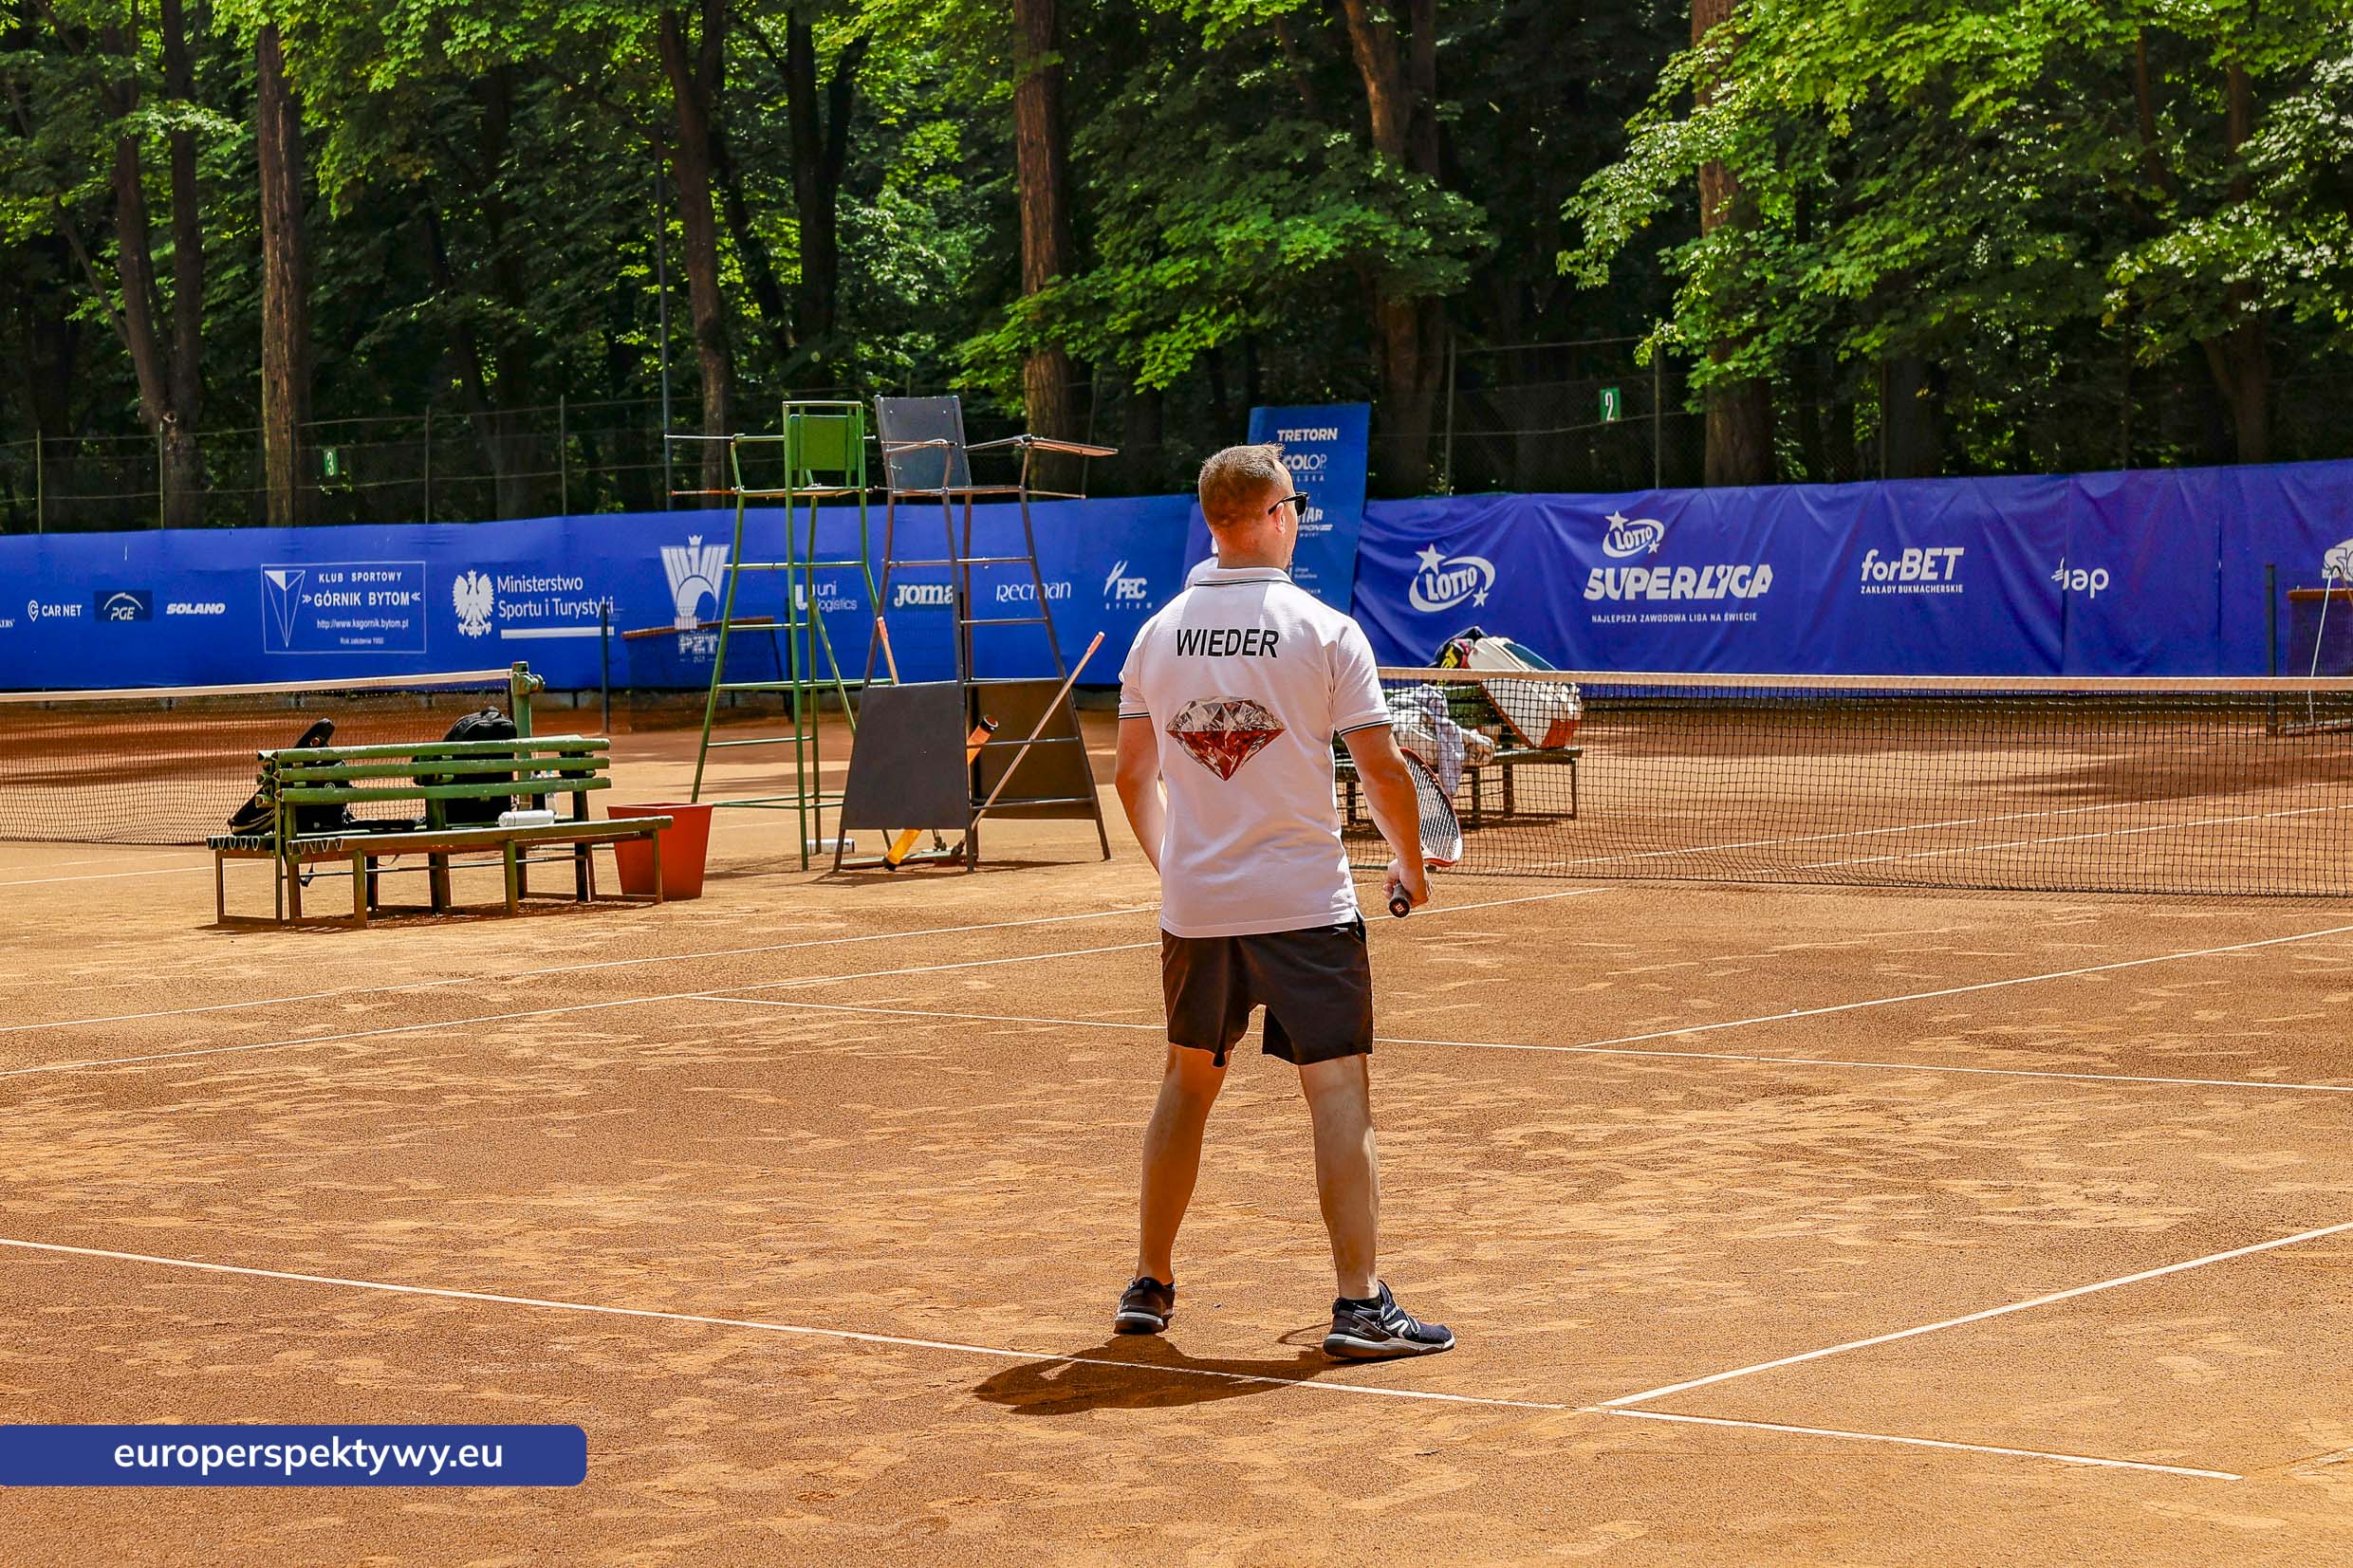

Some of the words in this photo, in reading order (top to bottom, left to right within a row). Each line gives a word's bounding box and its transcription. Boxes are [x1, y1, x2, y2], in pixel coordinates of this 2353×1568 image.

[1604, 392, 1615, 421] 2
[1277, 427, 1338, 442] TRETORN
[326, 452, 334, 476] 3
[1614, 526, 1653, 550] LOTTO
[1861, 546, 1965, 581] forBET
[319, 572, 343, 583] KLUB
[351, 571, 402, 582] SPORTOWY
[497, 574, 584, 593] Ministerstwo
[1425, 566, 1477, 600] LOTTO
[1116, 578, 1147, 600] PEC
[1898, 583, 1964, 594] BUKMACHERSKIE
[42, 604, 62, 617] CAR
[63, 604, 83, 617] NET
[110, 606, 135, 621] PGE
[166, 602, 226, 615] SOLANO
[498, 600, 542, 620] Sportu
[545, 599, 549, 616] i
[1592, 614, 1638, 623] NAJLEPSZA
[1640, 613, 1686, 623] ZAWODOWA
[1689, 613, 1708, 622] LIGA
[1711, 613, 1721, 622] NA
[1176, 628, 1279, 658] WIEDER
